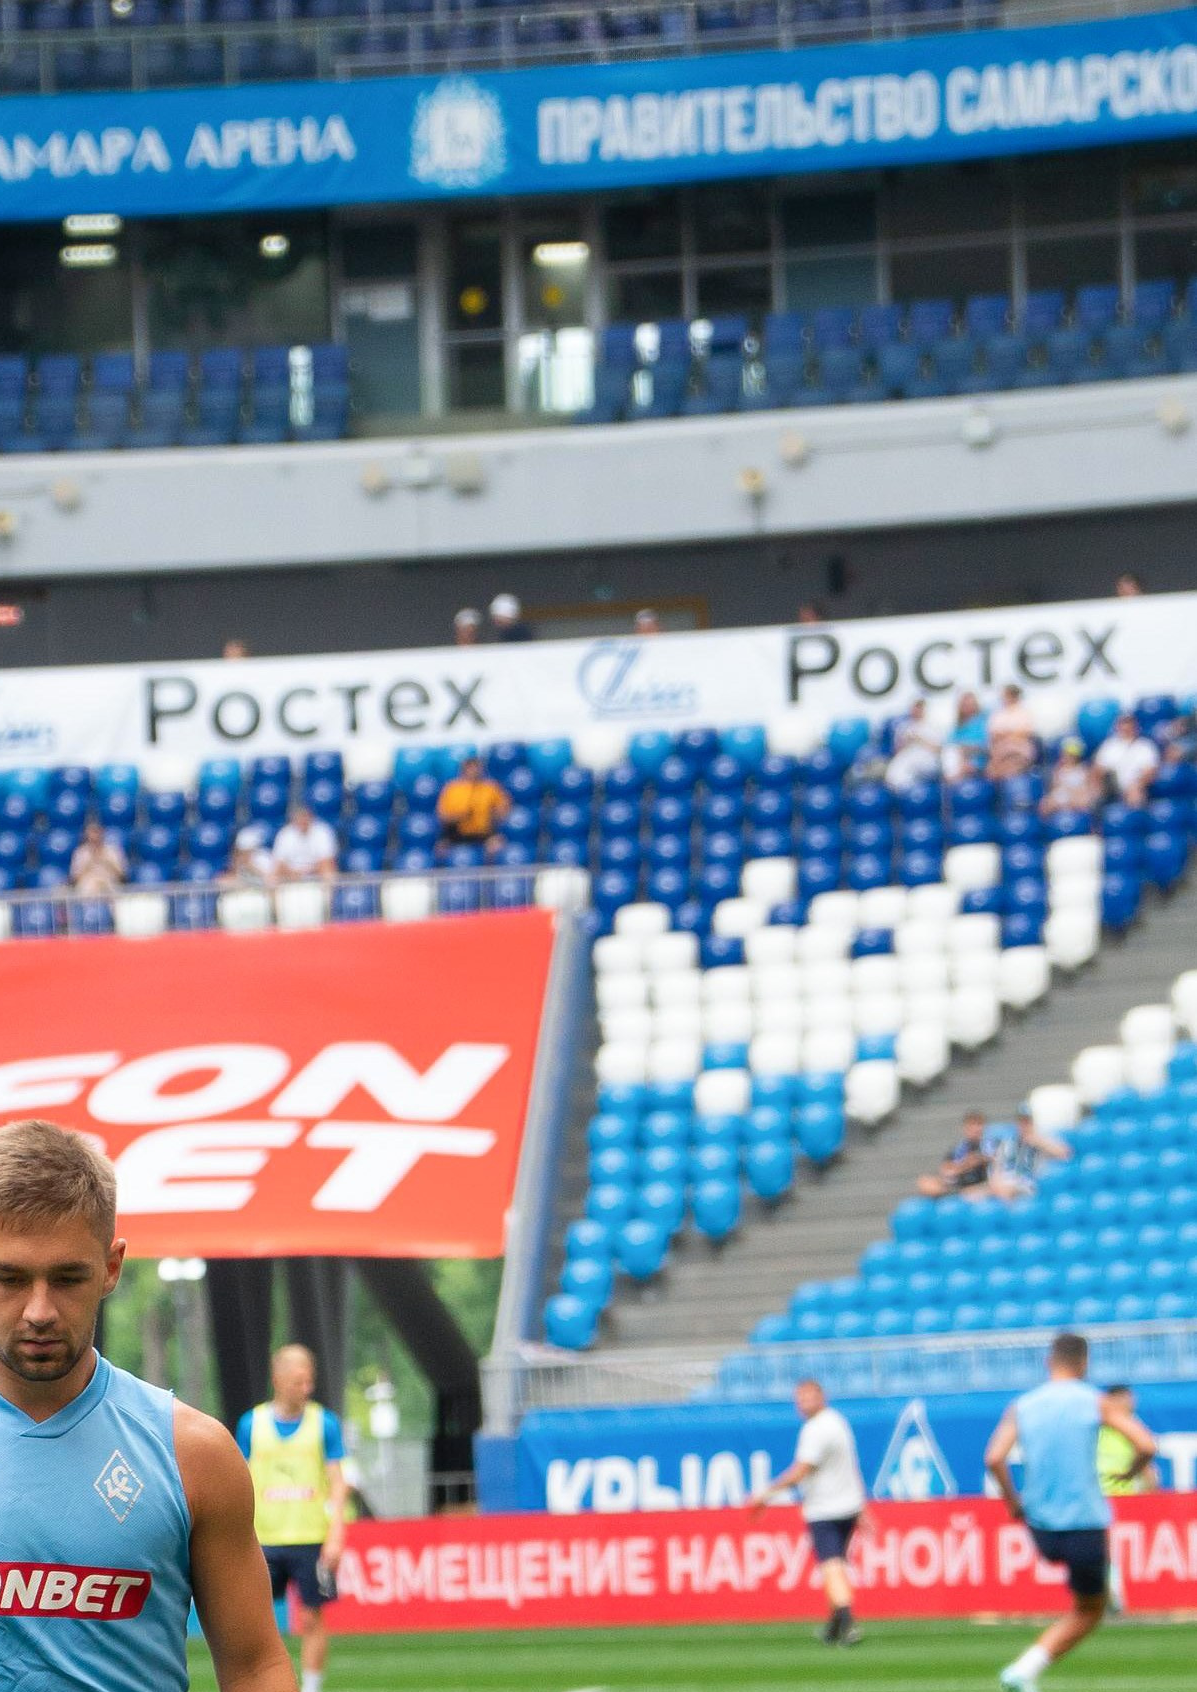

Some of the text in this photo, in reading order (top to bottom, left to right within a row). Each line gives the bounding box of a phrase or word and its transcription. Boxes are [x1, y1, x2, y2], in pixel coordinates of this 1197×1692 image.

[186, 115, 356, 168] АРЕНА
[538, 71, 939, 163] ПРАВИТЕЛЬСТВО
[785, 623, 1123, 704] Ростех
[145, 674, 488, 746] Ростех
[337, 1536, 659, 1610] АЗМЕЩЕНИЕ
[666, 1513, 984, 1594] НАРУНОЙ
